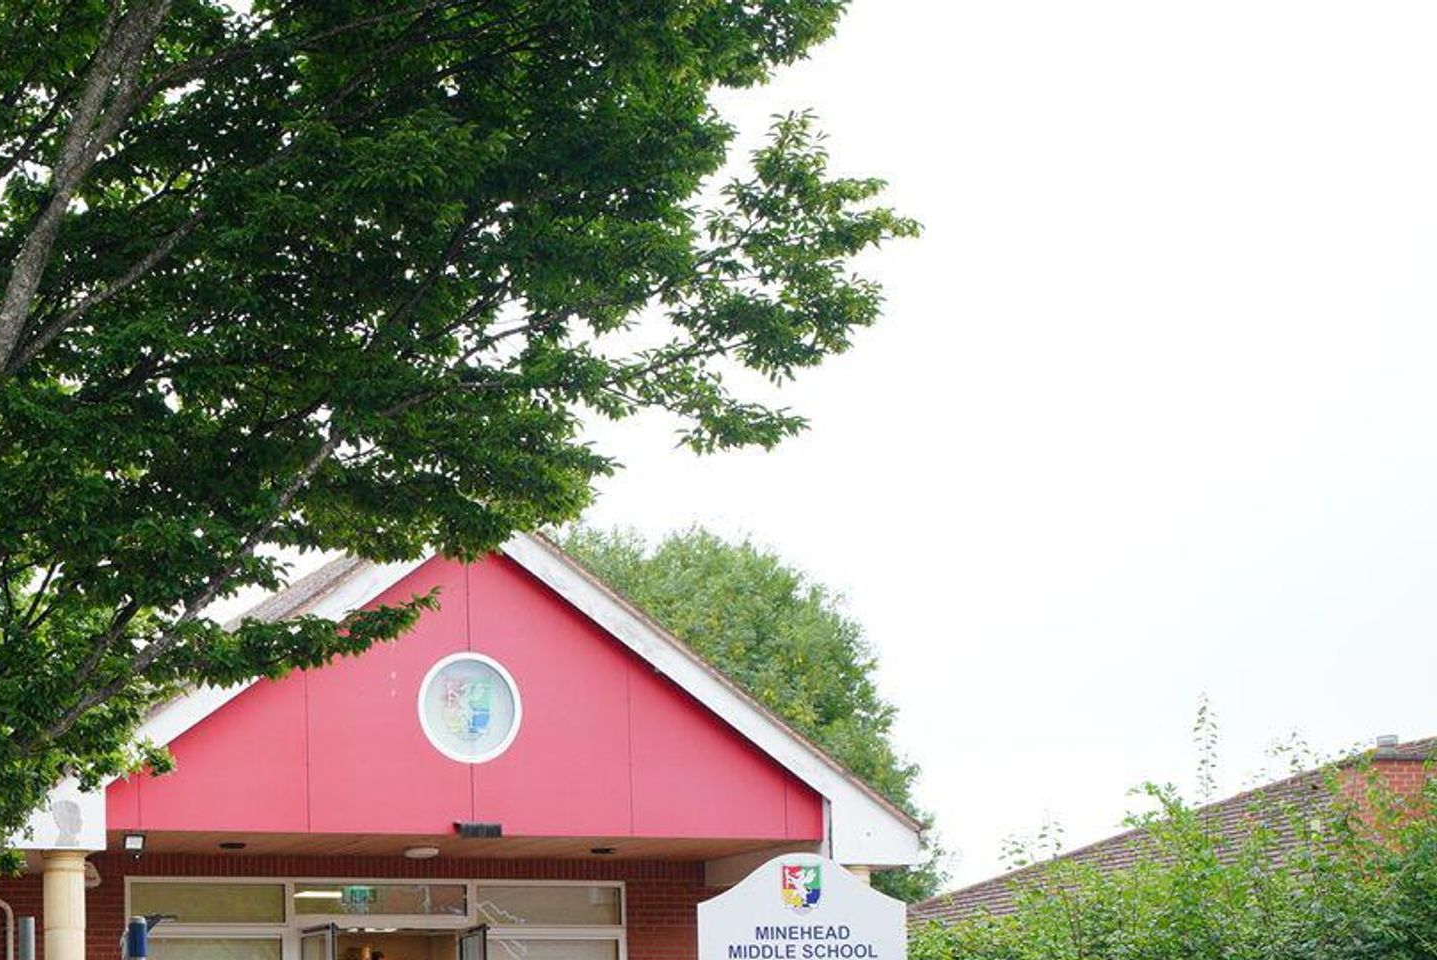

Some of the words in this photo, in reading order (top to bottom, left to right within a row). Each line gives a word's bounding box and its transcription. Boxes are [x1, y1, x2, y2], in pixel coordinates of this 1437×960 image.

[755, 926, 851, 940] MINEHEAD
[728, 945, 796, 959] MIDDLE
[802, 944, 878, 959] SCHOOL
